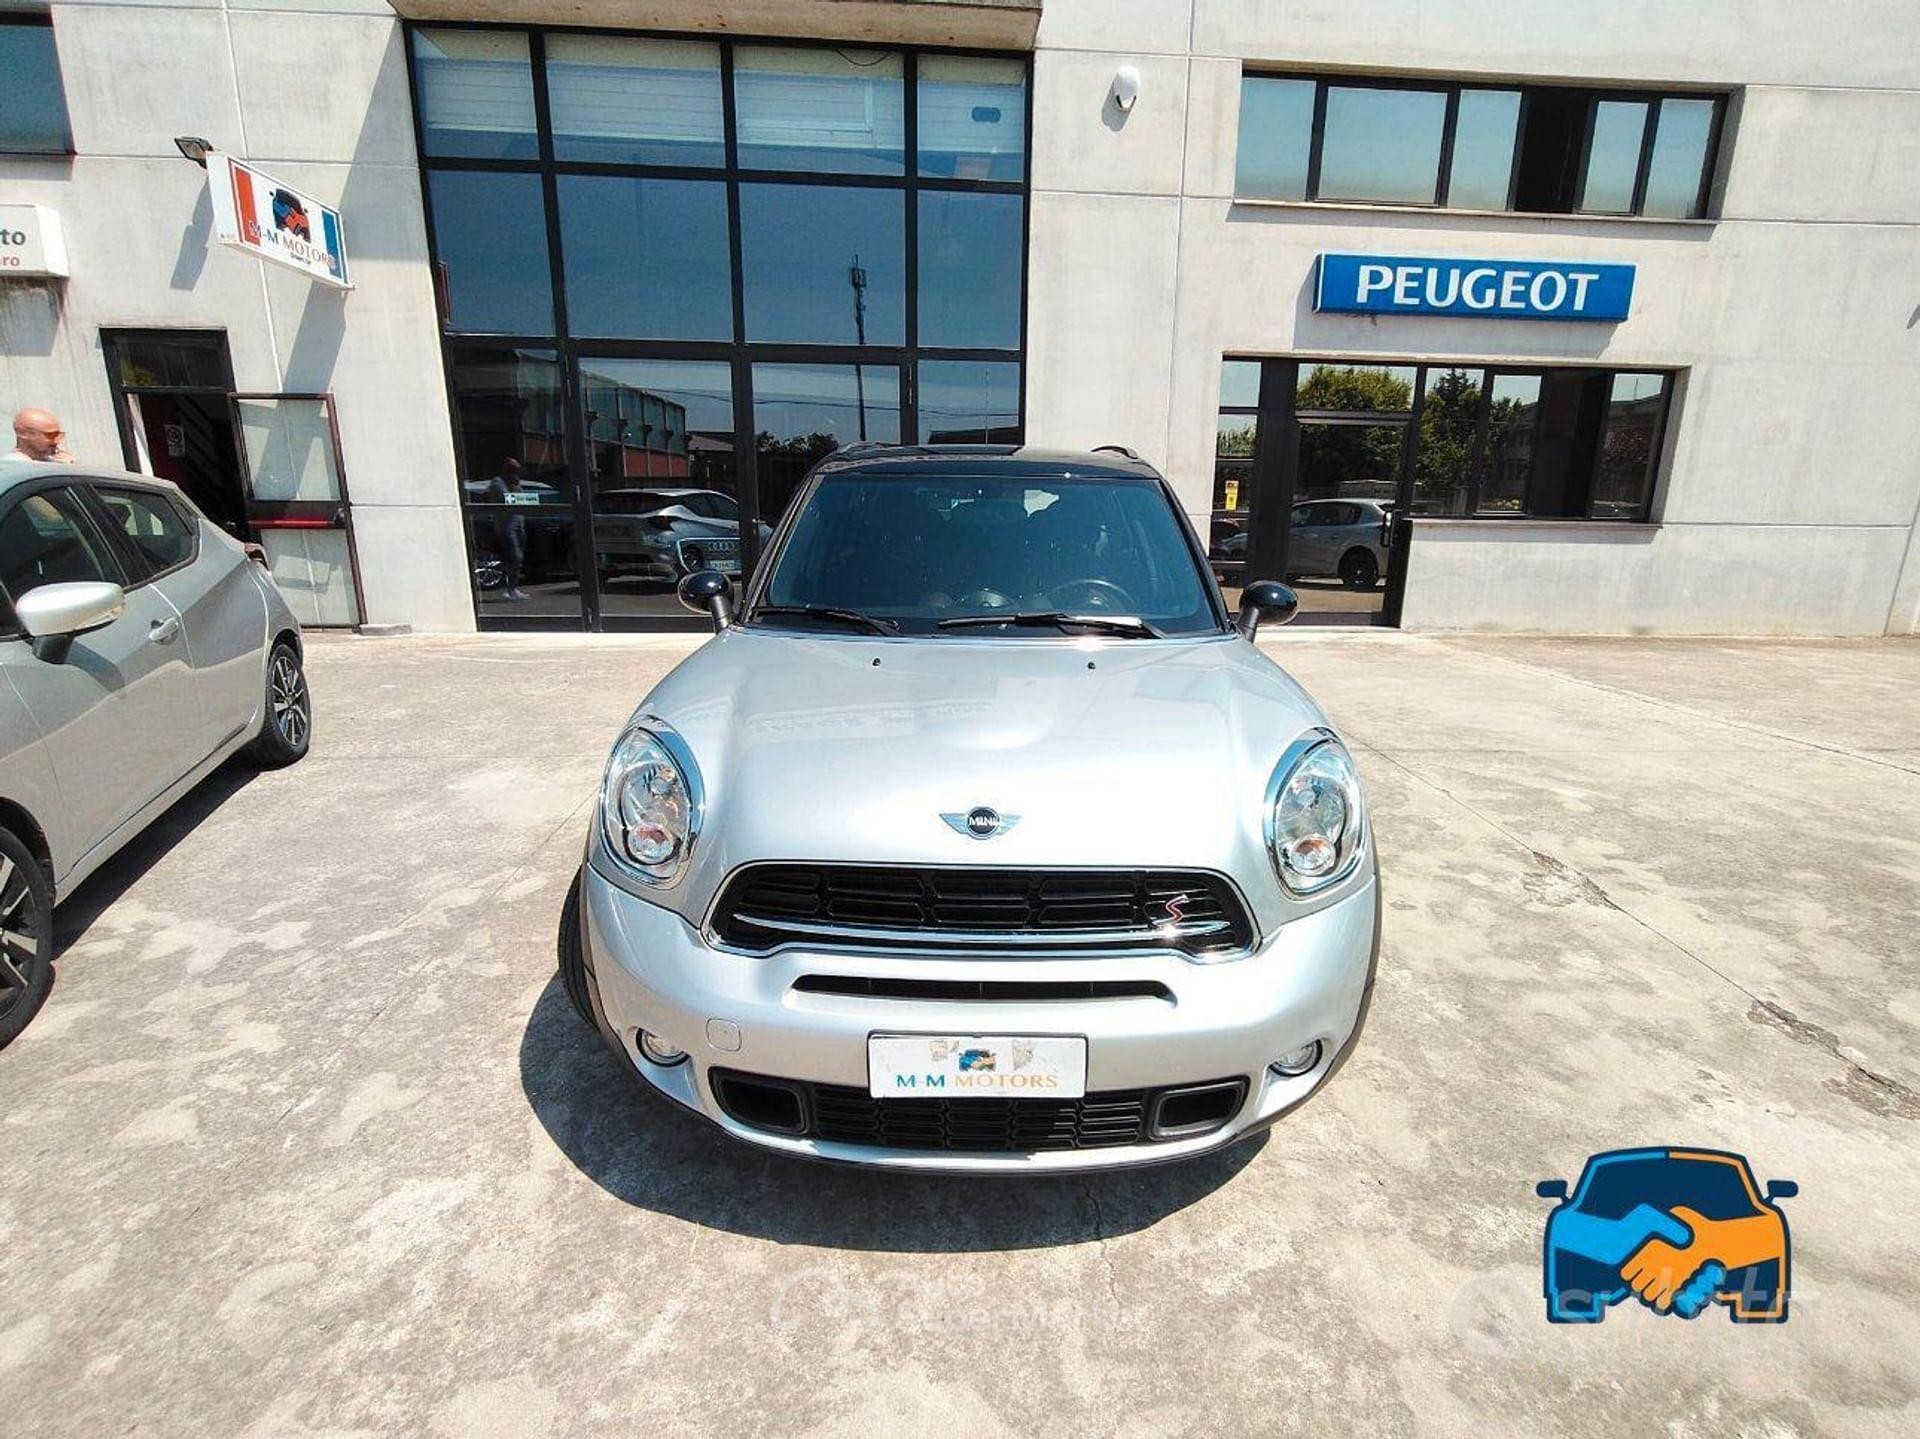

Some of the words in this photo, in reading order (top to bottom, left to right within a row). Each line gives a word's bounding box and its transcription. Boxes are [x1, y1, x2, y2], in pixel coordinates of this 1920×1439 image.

[282, 235, 336, 270] MOTORS
[1356, 264, 1599, 312] PEUGEOT
[968, 816, 998, 827] MINI
[955, 1074, 1058, 1088] MOTORS
